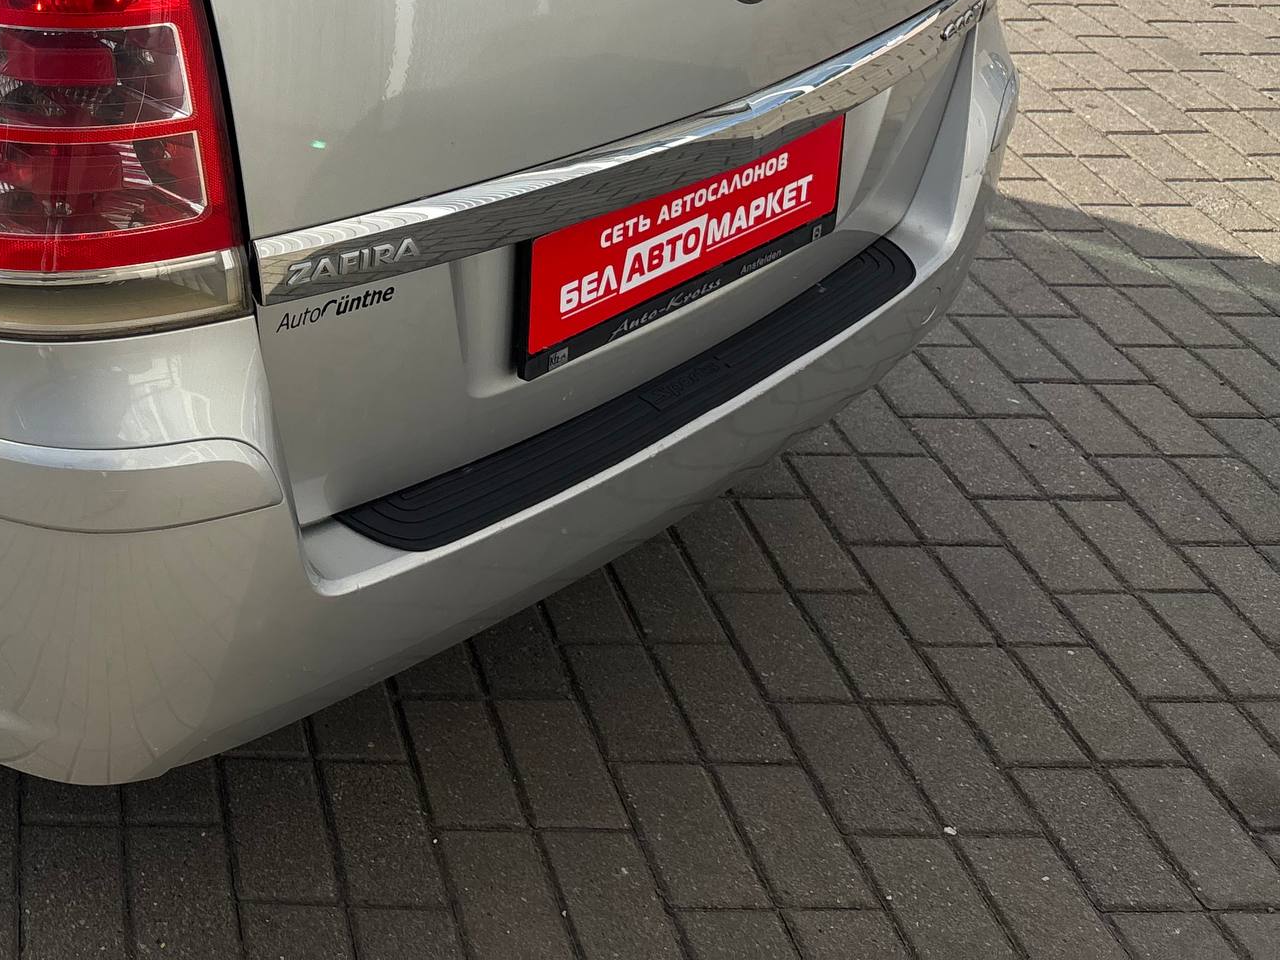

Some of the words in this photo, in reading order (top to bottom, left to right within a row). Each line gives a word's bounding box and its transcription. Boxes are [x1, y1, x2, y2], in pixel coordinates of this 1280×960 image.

[600, 214, 651, 248] СЕТЬ
[656, 152, 789, 224] АВТОСАЛОНОВ
[286, 237, 421, 287] ZAFIRA
[740, 248, 782, 275] Ansfelden
